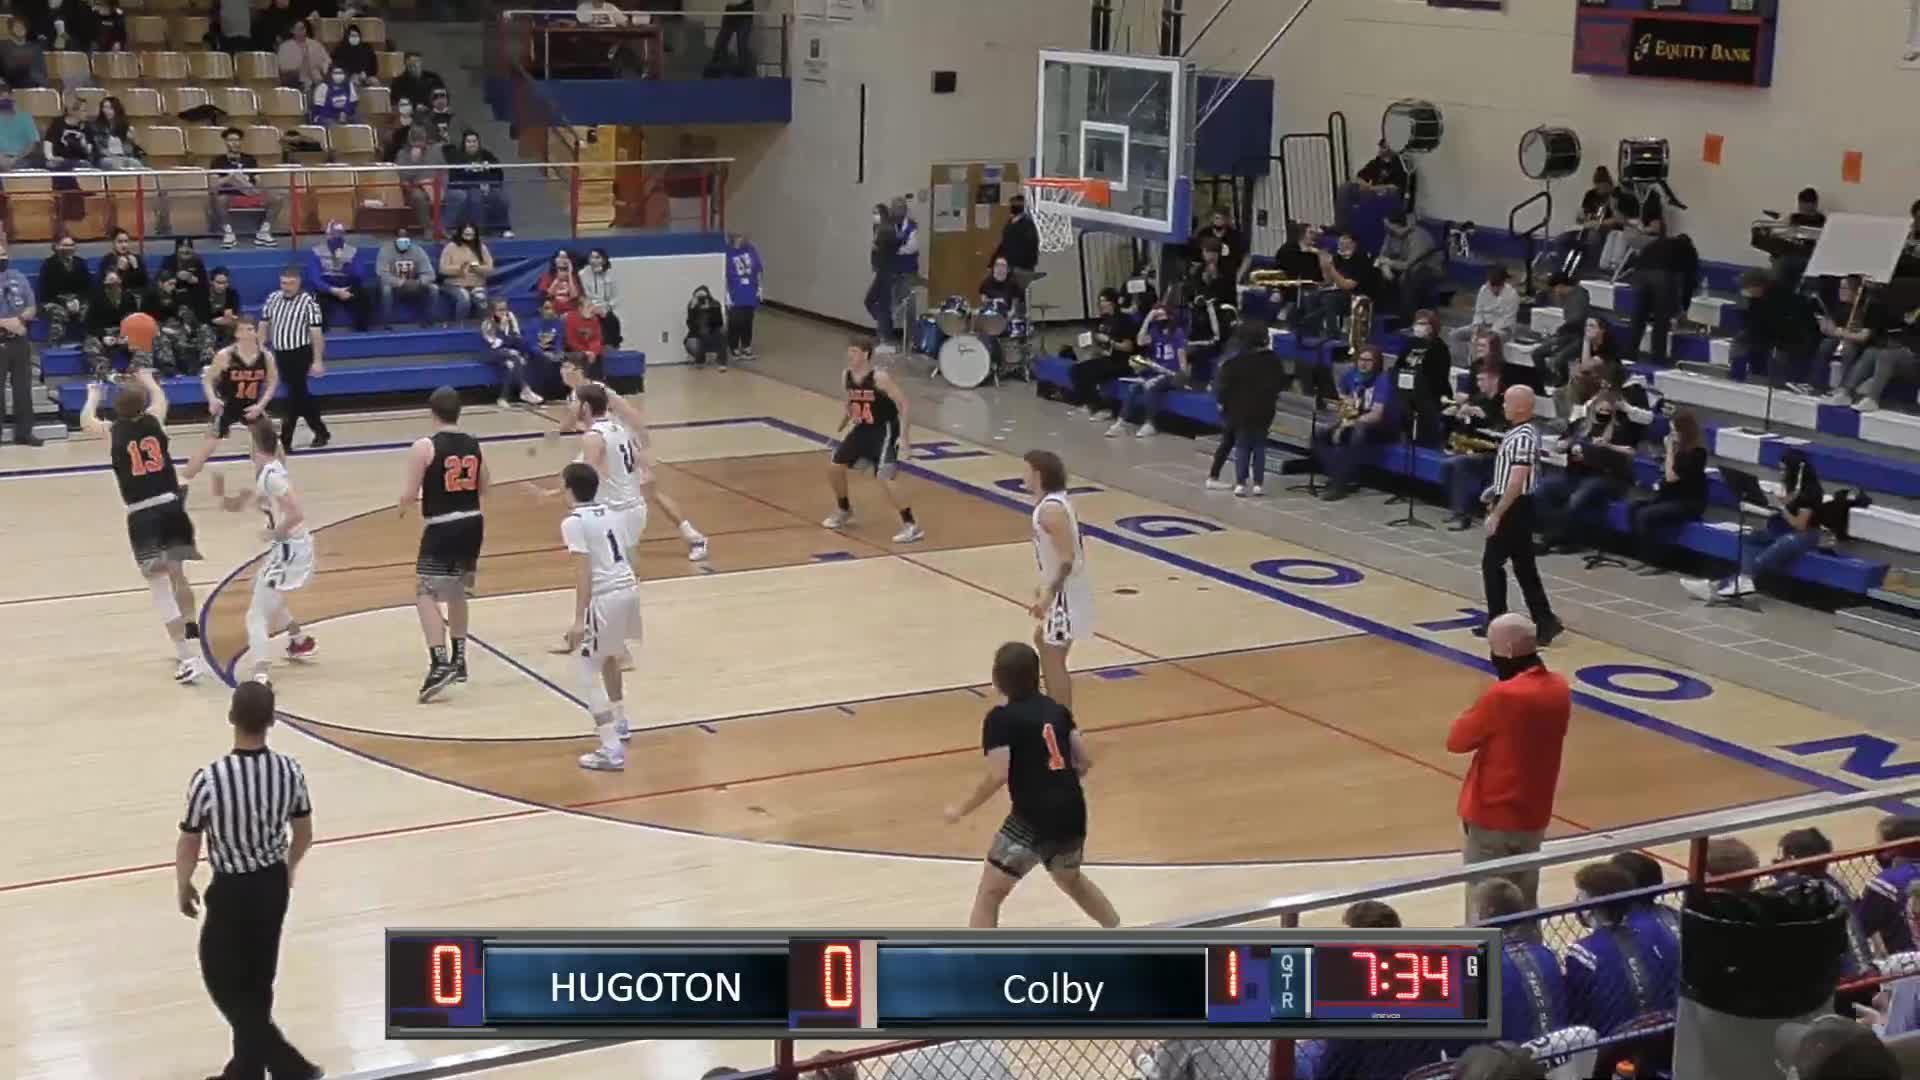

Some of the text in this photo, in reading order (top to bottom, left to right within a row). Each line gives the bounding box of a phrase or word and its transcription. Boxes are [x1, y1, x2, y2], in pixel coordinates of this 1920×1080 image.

[1655, 40, 1751, 62] EQUITY BANK
[127, 436, 164, 476] 13
[444, 455, 479, 492] 23
[606, 528, 624, 563] 1
[1042, 723, 1065, 770] 1
